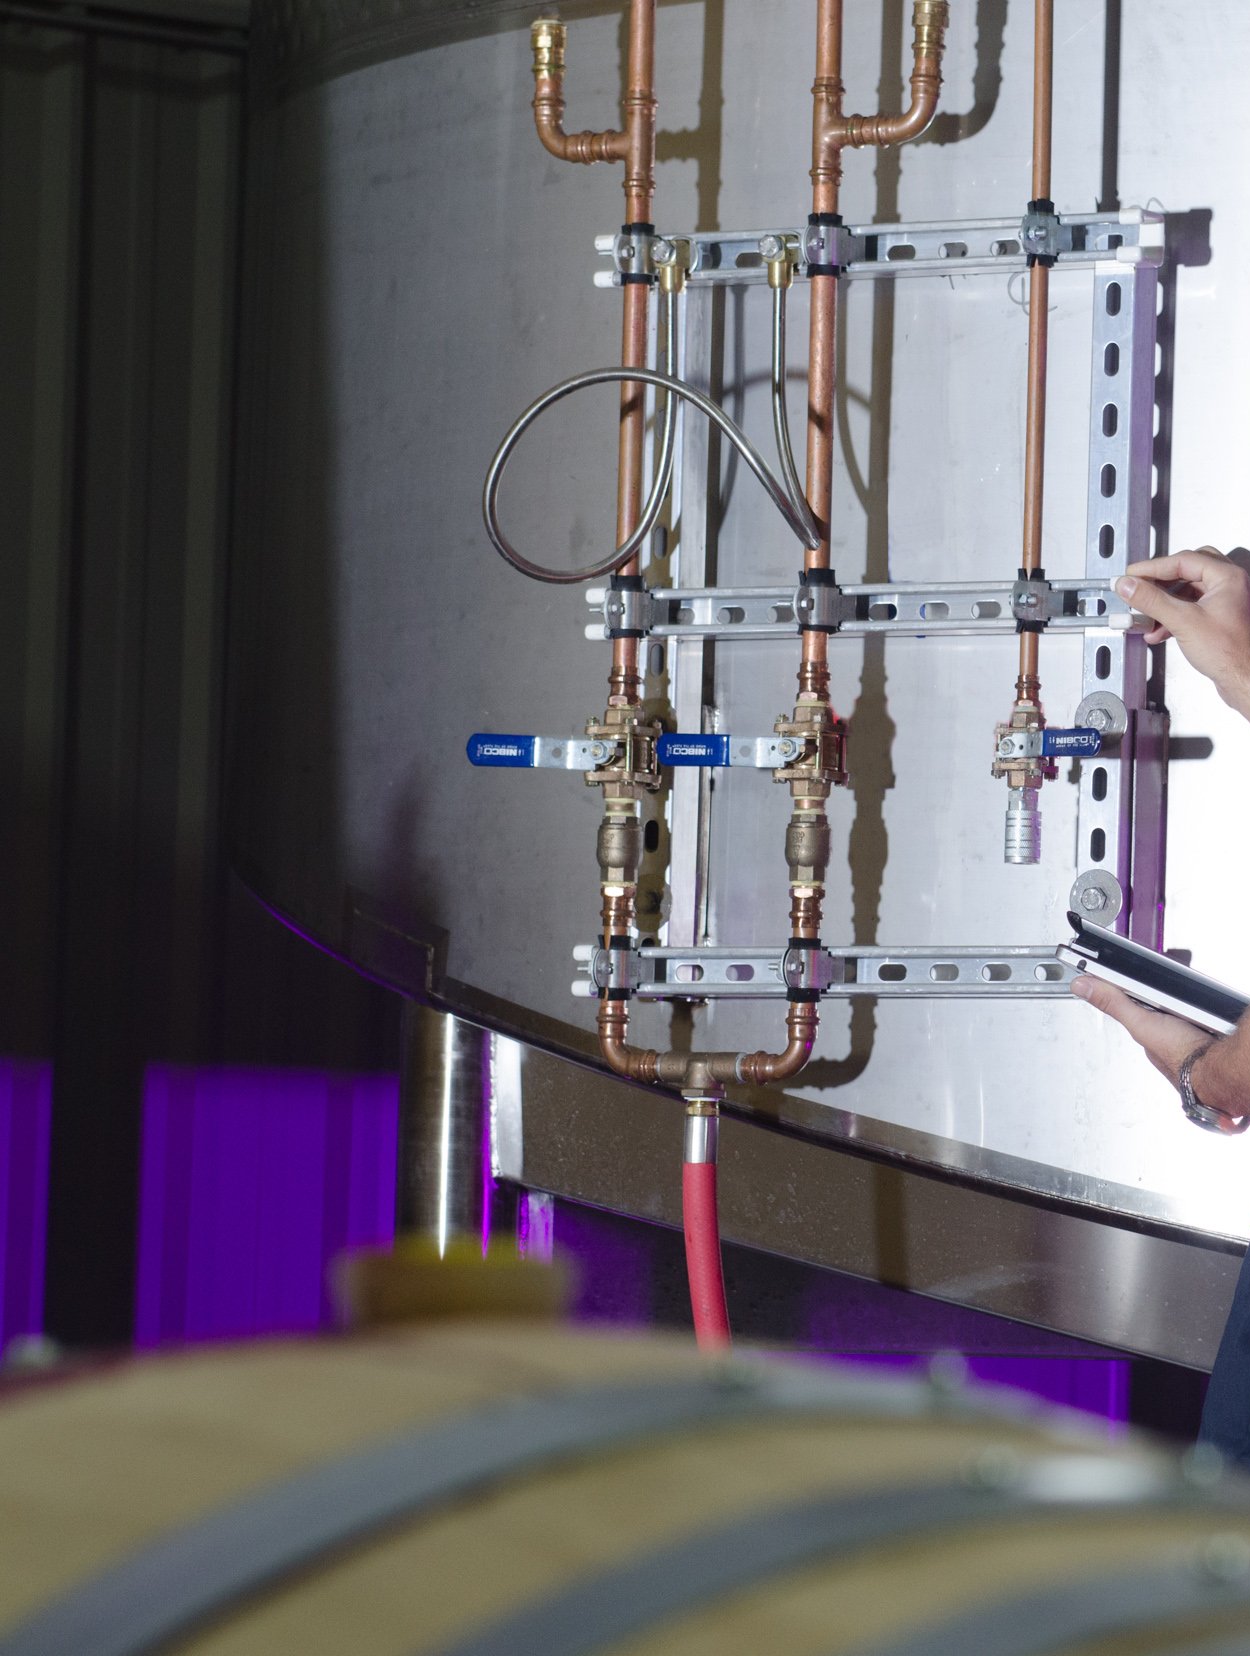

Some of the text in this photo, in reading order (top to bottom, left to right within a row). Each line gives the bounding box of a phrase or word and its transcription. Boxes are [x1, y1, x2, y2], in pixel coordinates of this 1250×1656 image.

[1056, 736, 1088, 744] NIBCO
[484, 748, 517, 757] NIBCO
[673, 748, 706, 756] NIBCO
